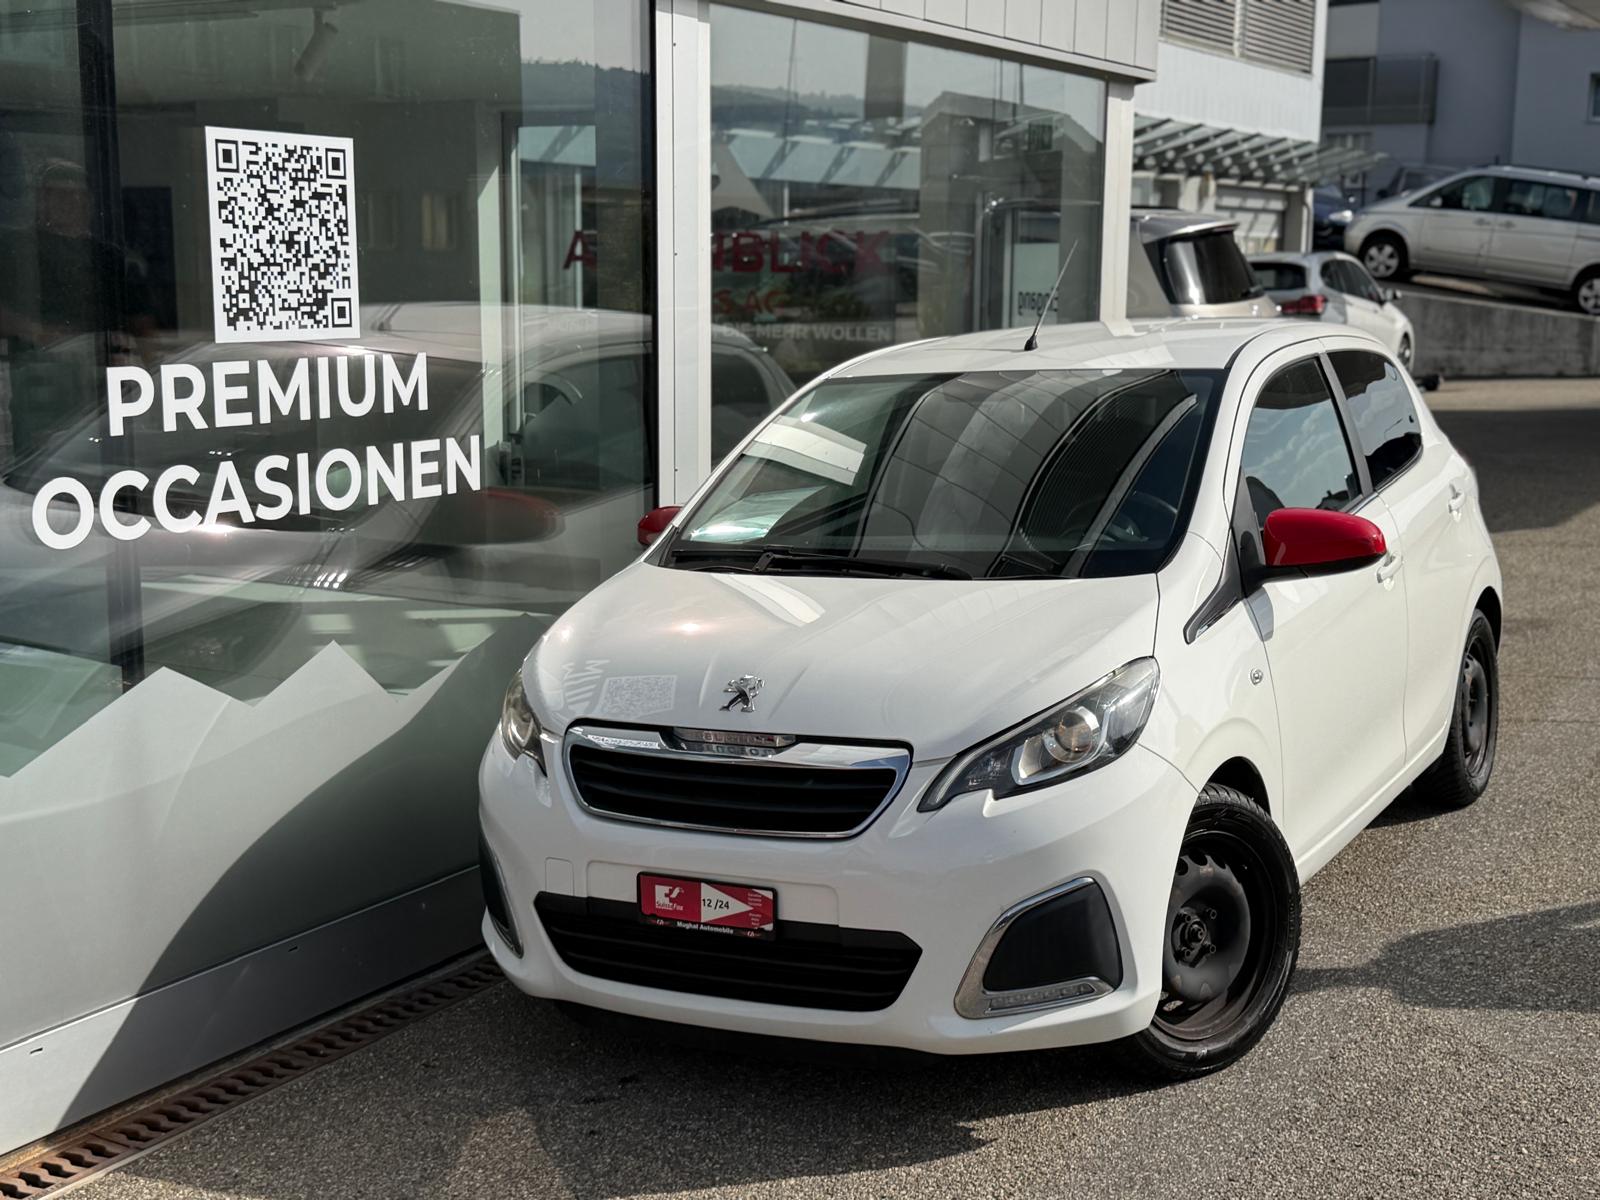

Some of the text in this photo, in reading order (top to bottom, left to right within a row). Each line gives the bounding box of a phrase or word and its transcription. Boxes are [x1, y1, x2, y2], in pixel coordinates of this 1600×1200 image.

[756, 323, 808, 340] MEHR
[810, 324, 892, 342] WOLLEN
[106, 352, 429, 437] PREMIUM
[31, 435, 482, 550] OCCASIONEN
[702, 898, 730, 911] 12 /24
[676, 921, 734, 936] Mughal Automobile
